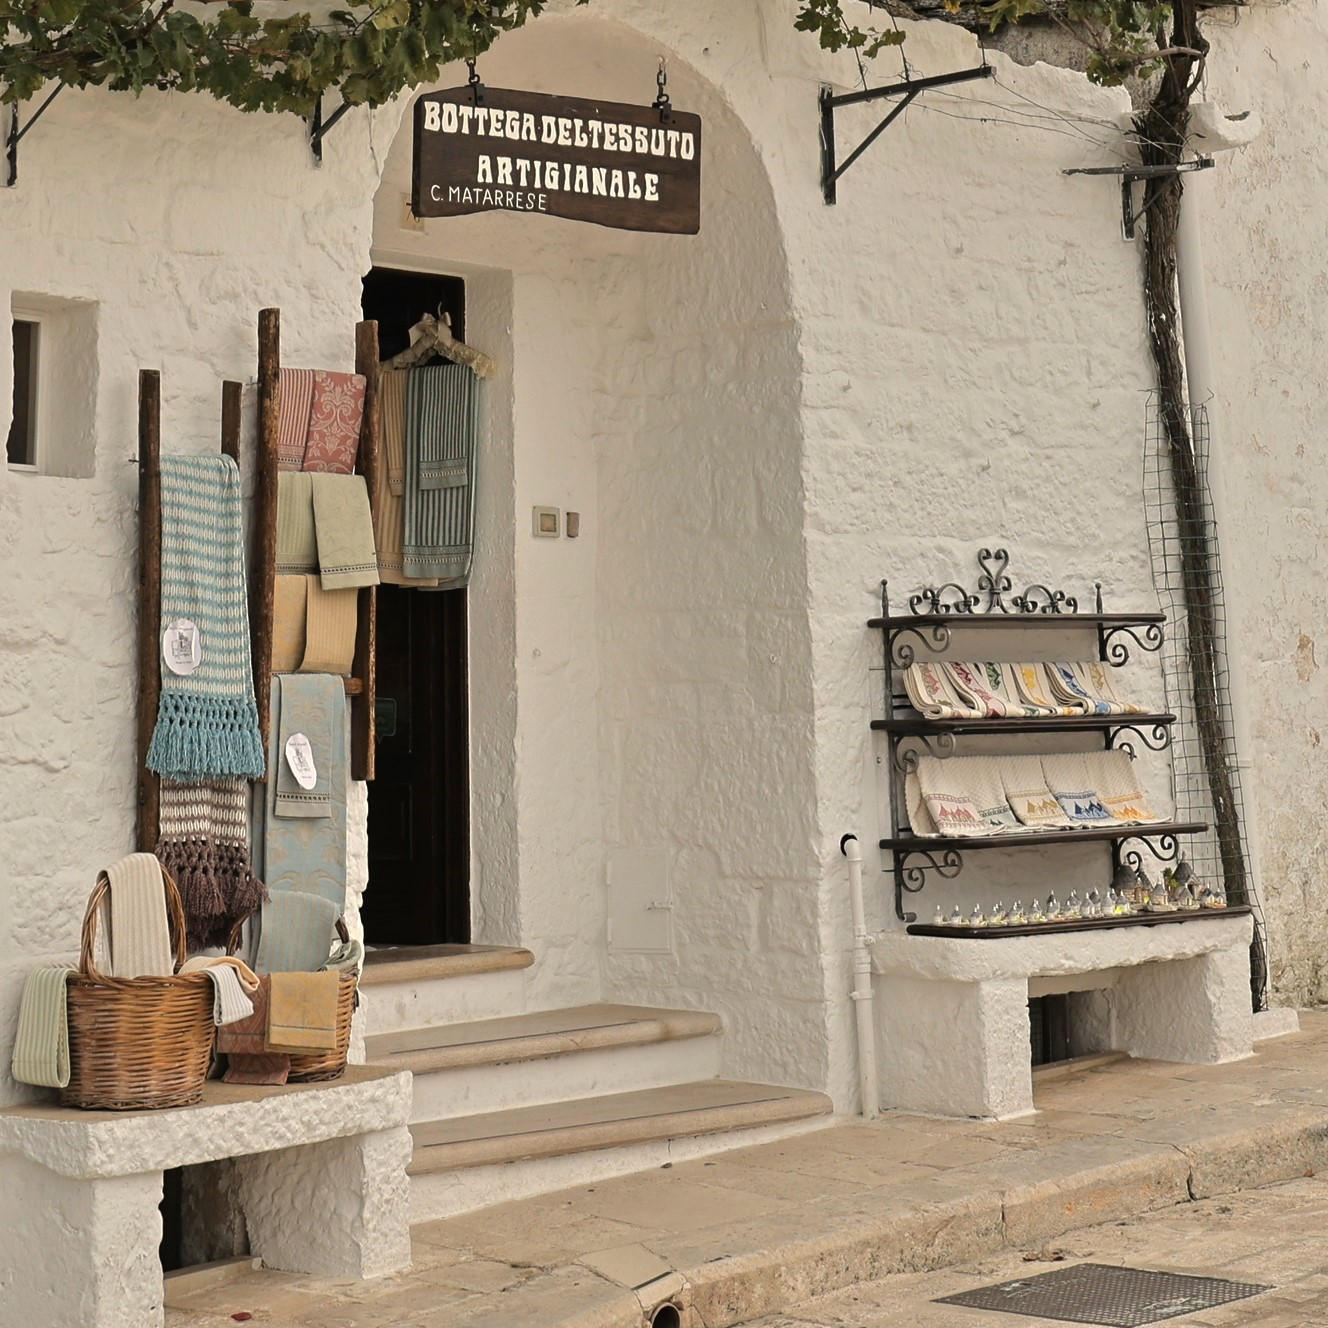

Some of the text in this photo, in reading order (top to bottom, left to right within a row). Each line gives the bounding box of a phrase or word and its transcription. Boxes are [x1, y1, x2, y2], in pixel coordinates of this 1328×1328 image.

[424, 101, 695, 160] BOTTEGA DEL TESSUTO
[430, 184, 547, 210] C. MATARRESE
[477, 154, 659, 201] ARTIGIANALE
